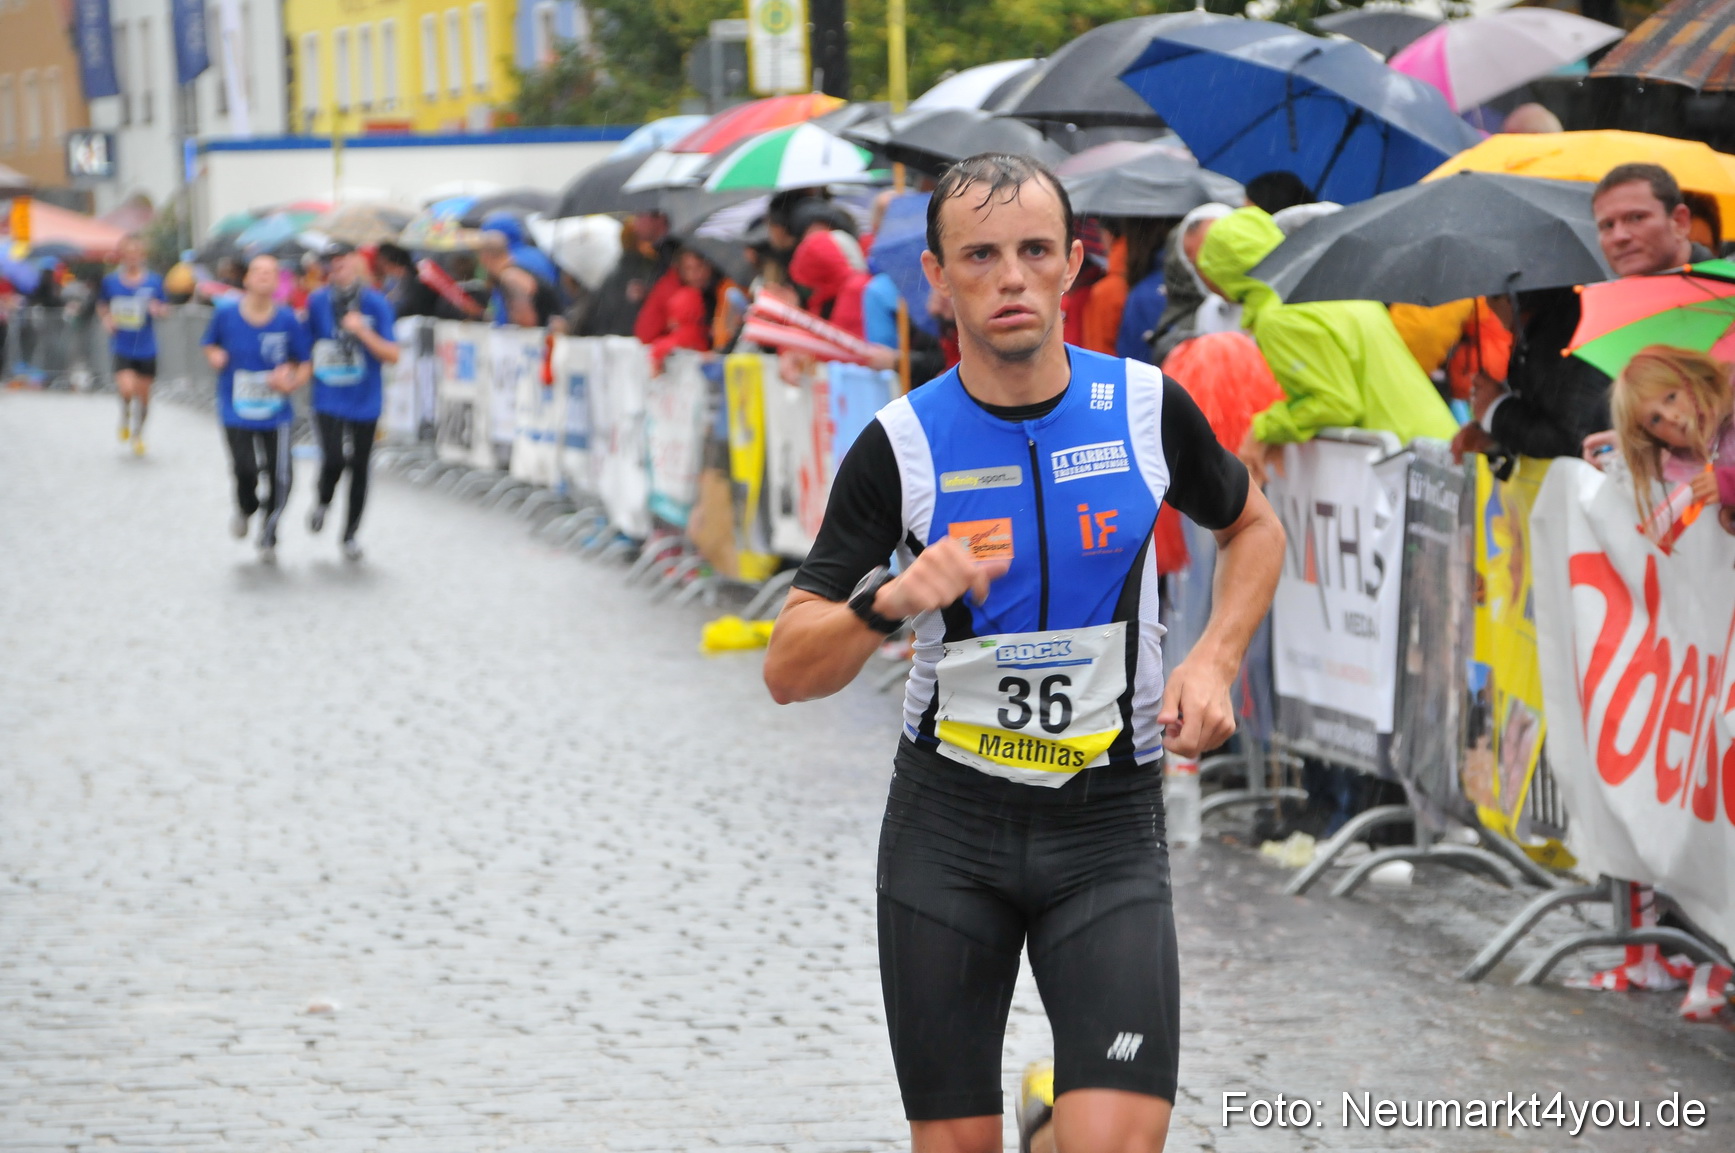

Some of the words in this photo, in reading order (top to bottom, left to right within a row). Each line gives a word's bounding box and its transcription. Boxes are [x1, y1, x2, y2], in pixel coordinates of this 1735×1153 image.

[1090, 400, 1113, 411] cep
[1051, 455, 1070, 470] LA
[1071, 446, 1128, 466] CARRERA
[1053, 464, 1093, 478] TRITEAM
[997, 640, 1072, 661] BOCK
[998, 674, 1073, 734] 36
[978, 734, 1085, 767] Matthias
